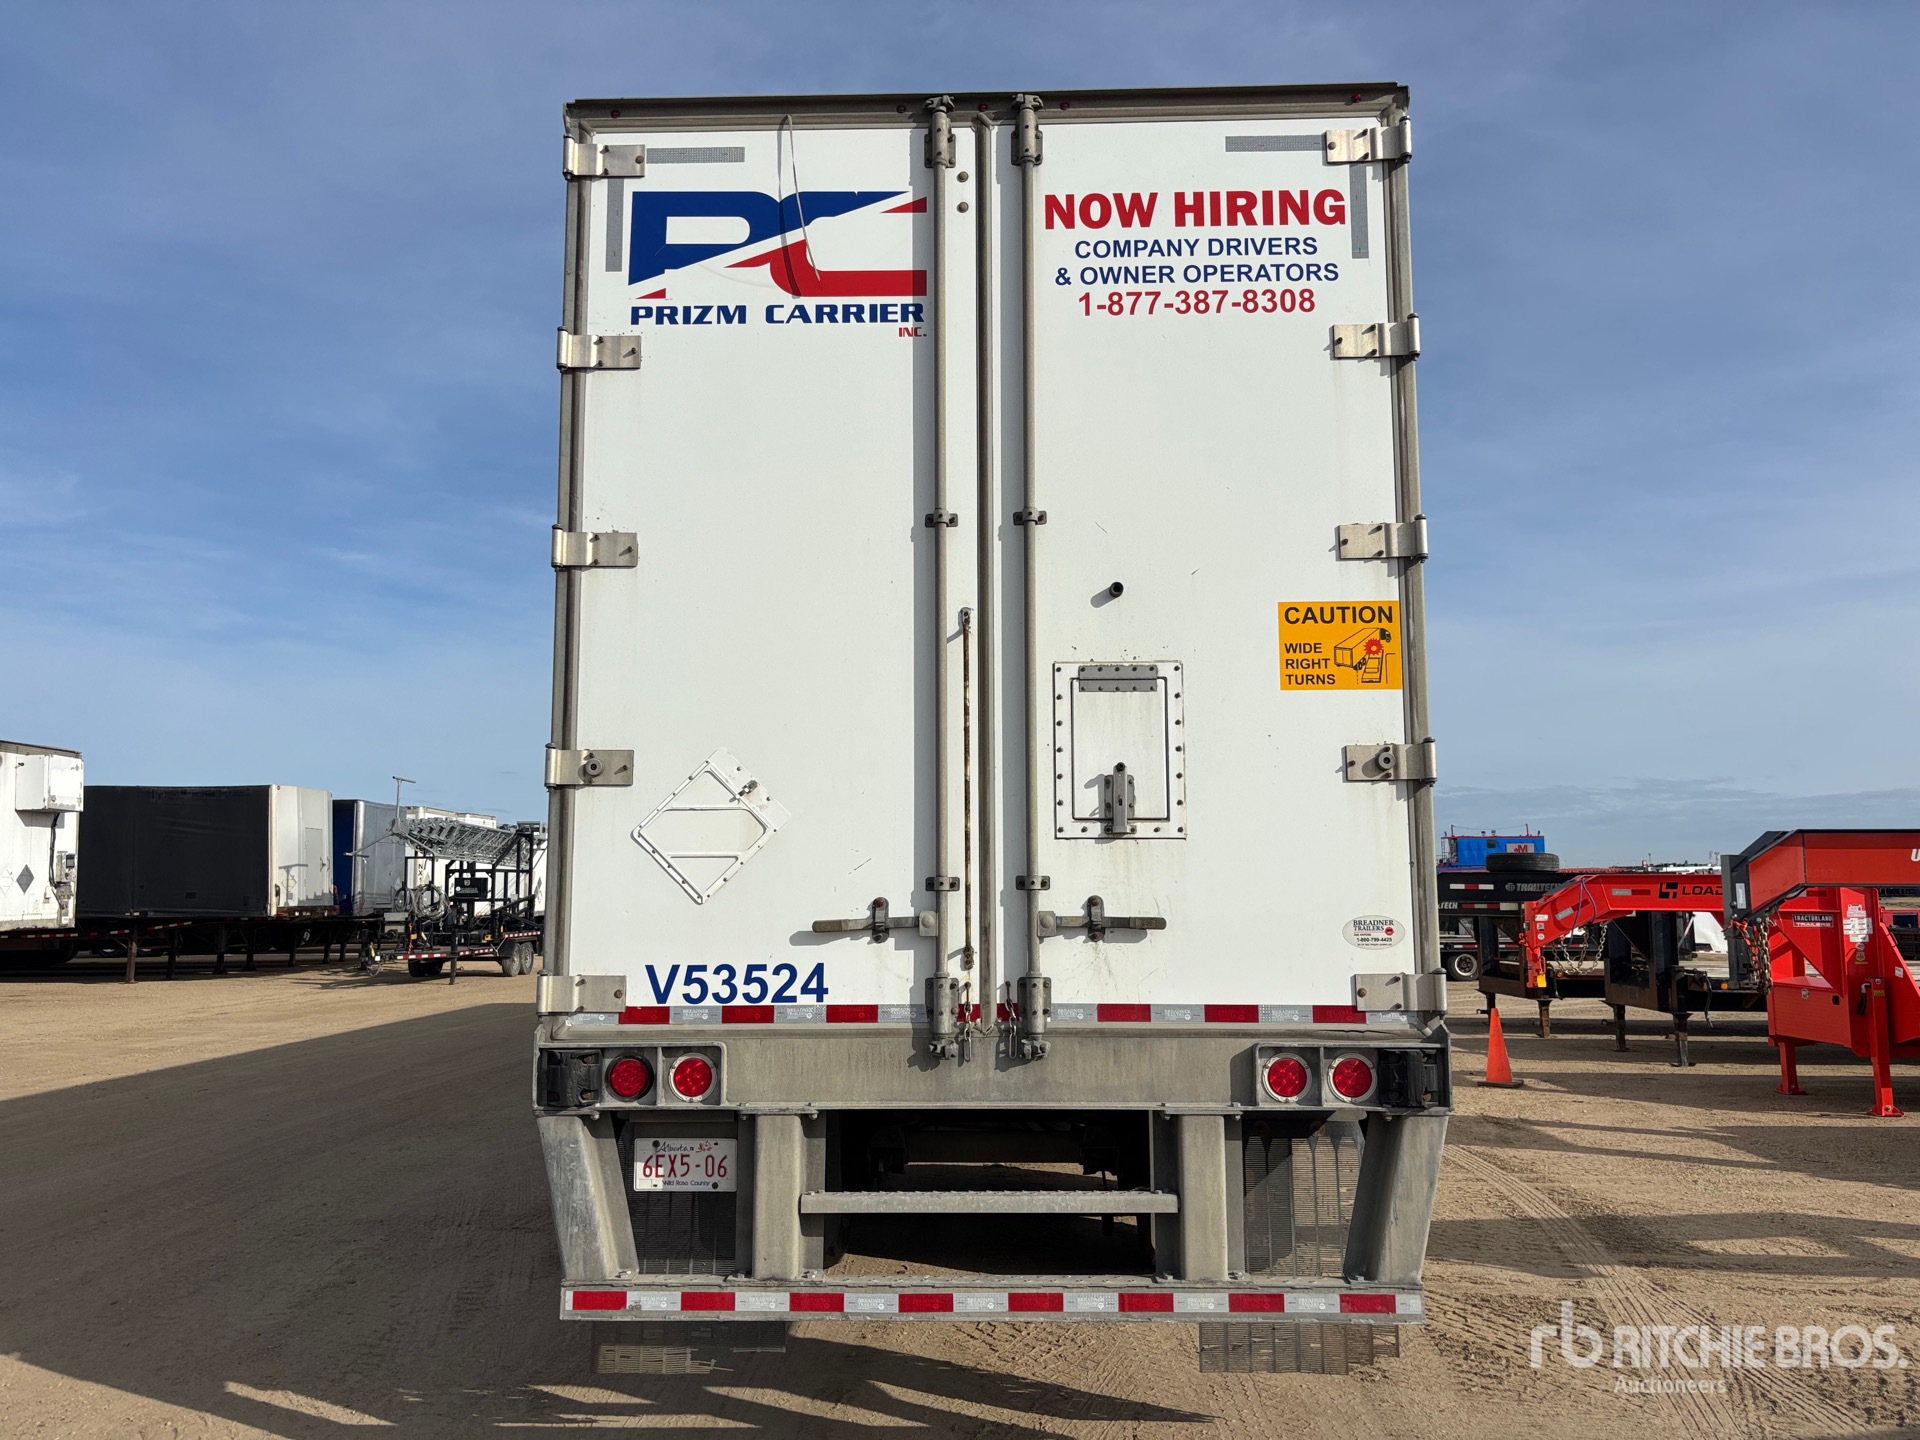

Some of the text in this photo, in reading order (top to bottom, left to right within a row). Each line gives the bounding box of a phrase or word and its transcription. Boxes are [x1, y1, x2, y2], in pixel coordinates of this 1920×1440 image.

[1044, 188, 1346, 229] NOW HIRING
[1074, 236, 1318, 259] COMPANY DRIVERS
[1055, 263, 1339, 286] & OWNER OPERATORS
[1078, 288, 1315, 316] 1-877-387-8308
[630, 303, 925, 325] PRIZM CARRIER
[898, 326, 927, 337] INC.
[1284, 605, 1393, 624] CAUTION
[1284, 642, 1322, 654] WIDE
[1285, 658, 1330, 669] RIGHT
[1285, 673, 1336, 685] TURNS
[1516, 883, 1562, 891] TRAILTEC
[645, 962, 829, 1005] V53524
[657, 1141, 688, 1152] Alberta
